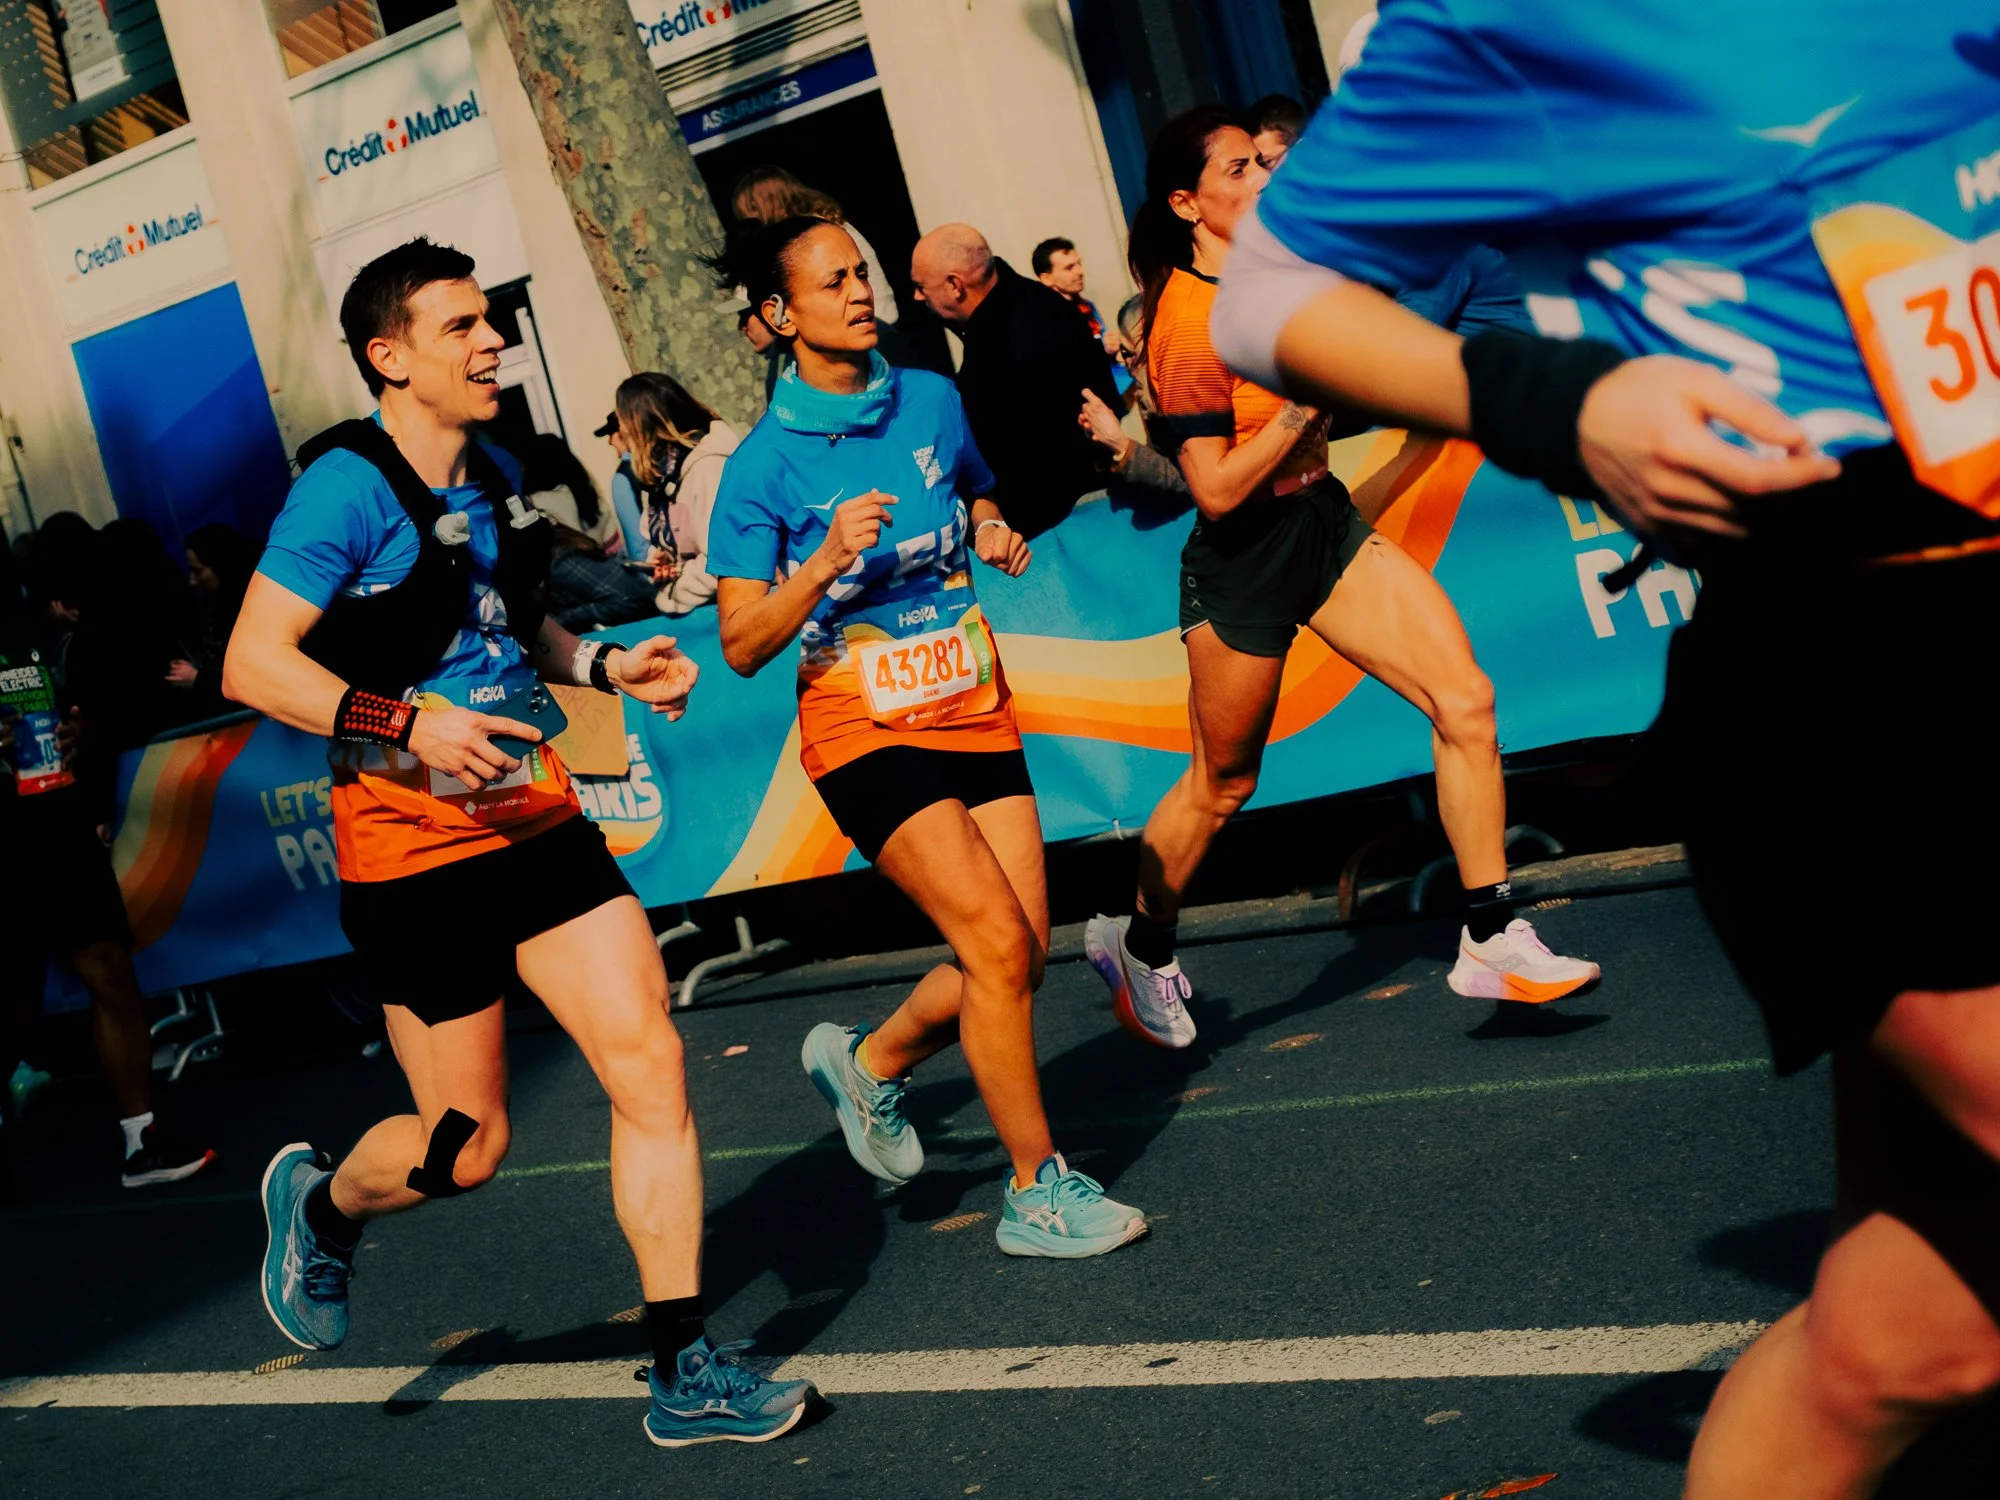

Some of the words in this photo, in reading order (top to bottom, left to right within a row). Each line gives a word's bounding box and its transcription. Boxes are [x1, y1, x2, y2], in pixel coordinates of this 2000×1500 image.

[635, 1, 705, 49] Crédit
[325, 132, 386, 175] Crédit
[405, 89, 479, 143] Mutuel
[701, 80, 802, 131] ASSURANCES
[74, 236, 126, 274] Crédit
[143, 203, 203, 246] Mutuel
[897, 604, 939, 629] HOKA
[1575, 541, 1704, 640] PA
[875, 635, 972, 694] 43282
[469, 685, 507, 705] HOKA
[260, 776, 333, 828] LET'S
[570, 762, 664, 820] ARIS
[275, 824, 341, 892] PA
